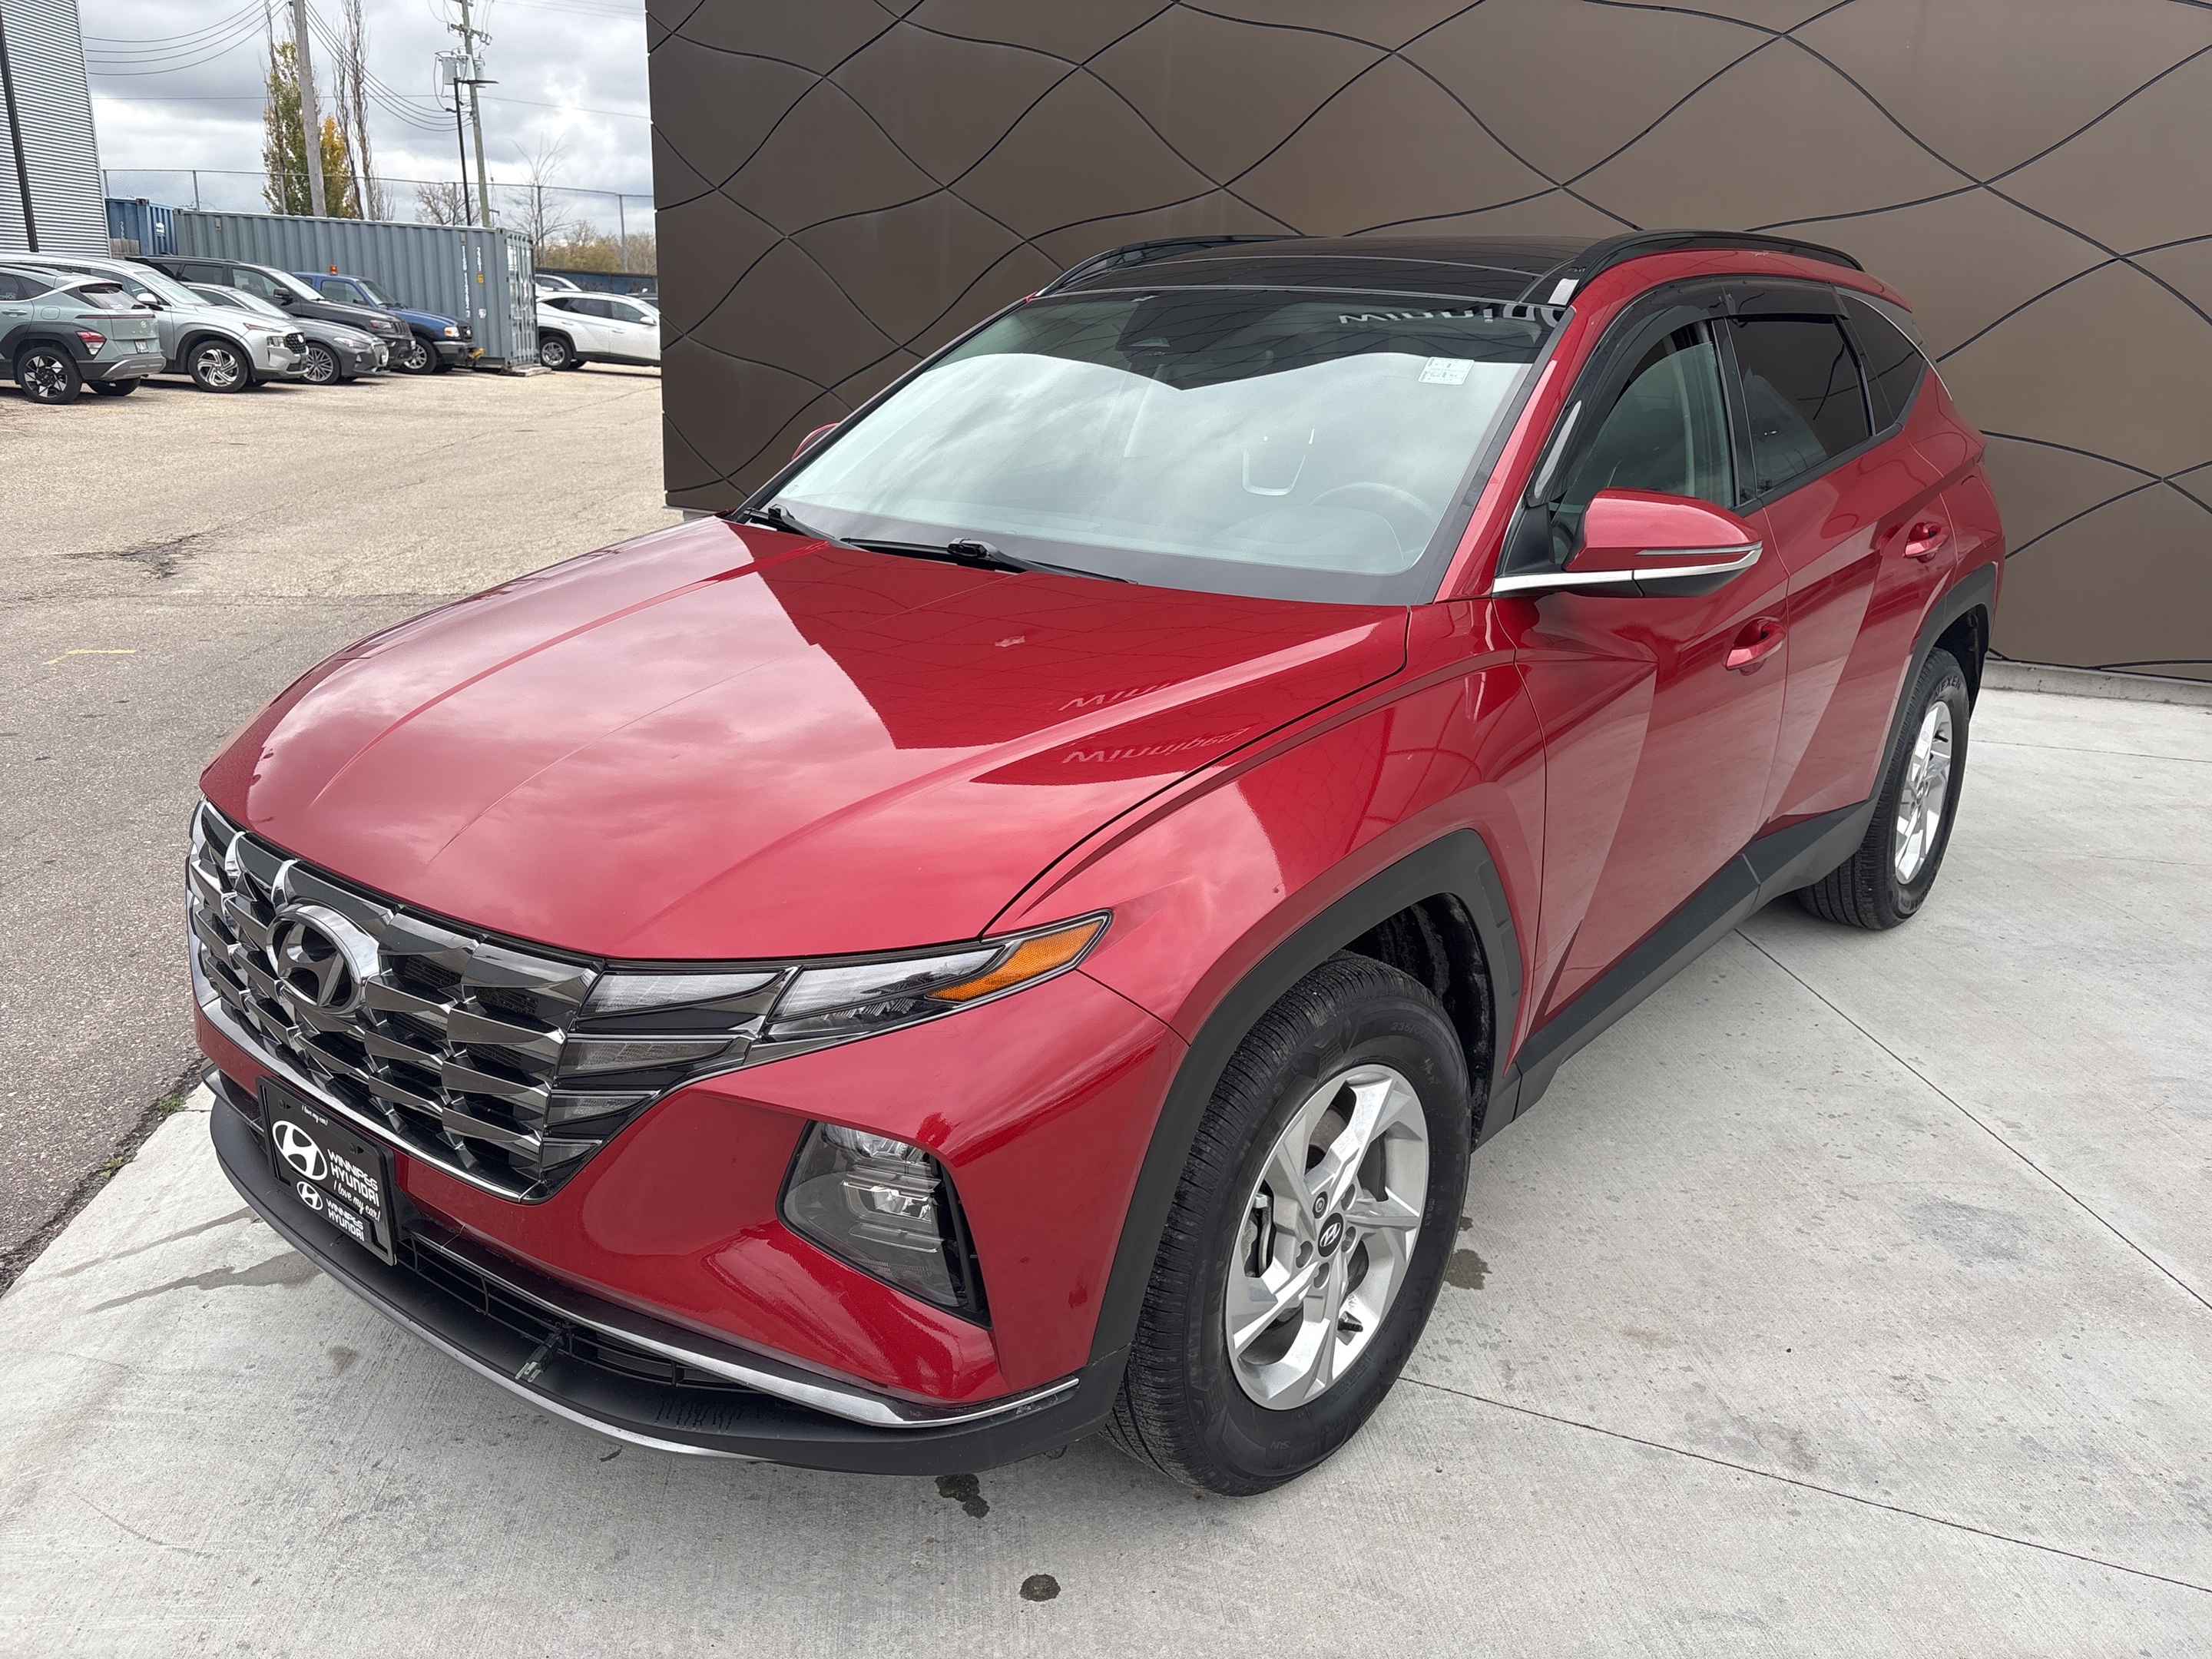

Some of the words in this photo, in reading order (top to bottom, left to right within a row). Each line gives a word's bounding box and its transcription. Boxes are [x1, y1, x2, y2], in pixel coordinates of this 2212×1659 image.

[1933, 677, 1962, 700] NEXEN
[313, 1113, 319, 1123] my
[327, 1148, 378, 1191] WINNIPEG
[330, 1163, 379, 1207] HYUNDAI
[326, 1198, 363, 1230] WINNIPEG
[338, 1184, 353, 1202] love
[353, 1197, 364, 1215] my
[365, 1205, 381, 1222] car!
[328, 1210, 365, 1242] HYUNDAI
